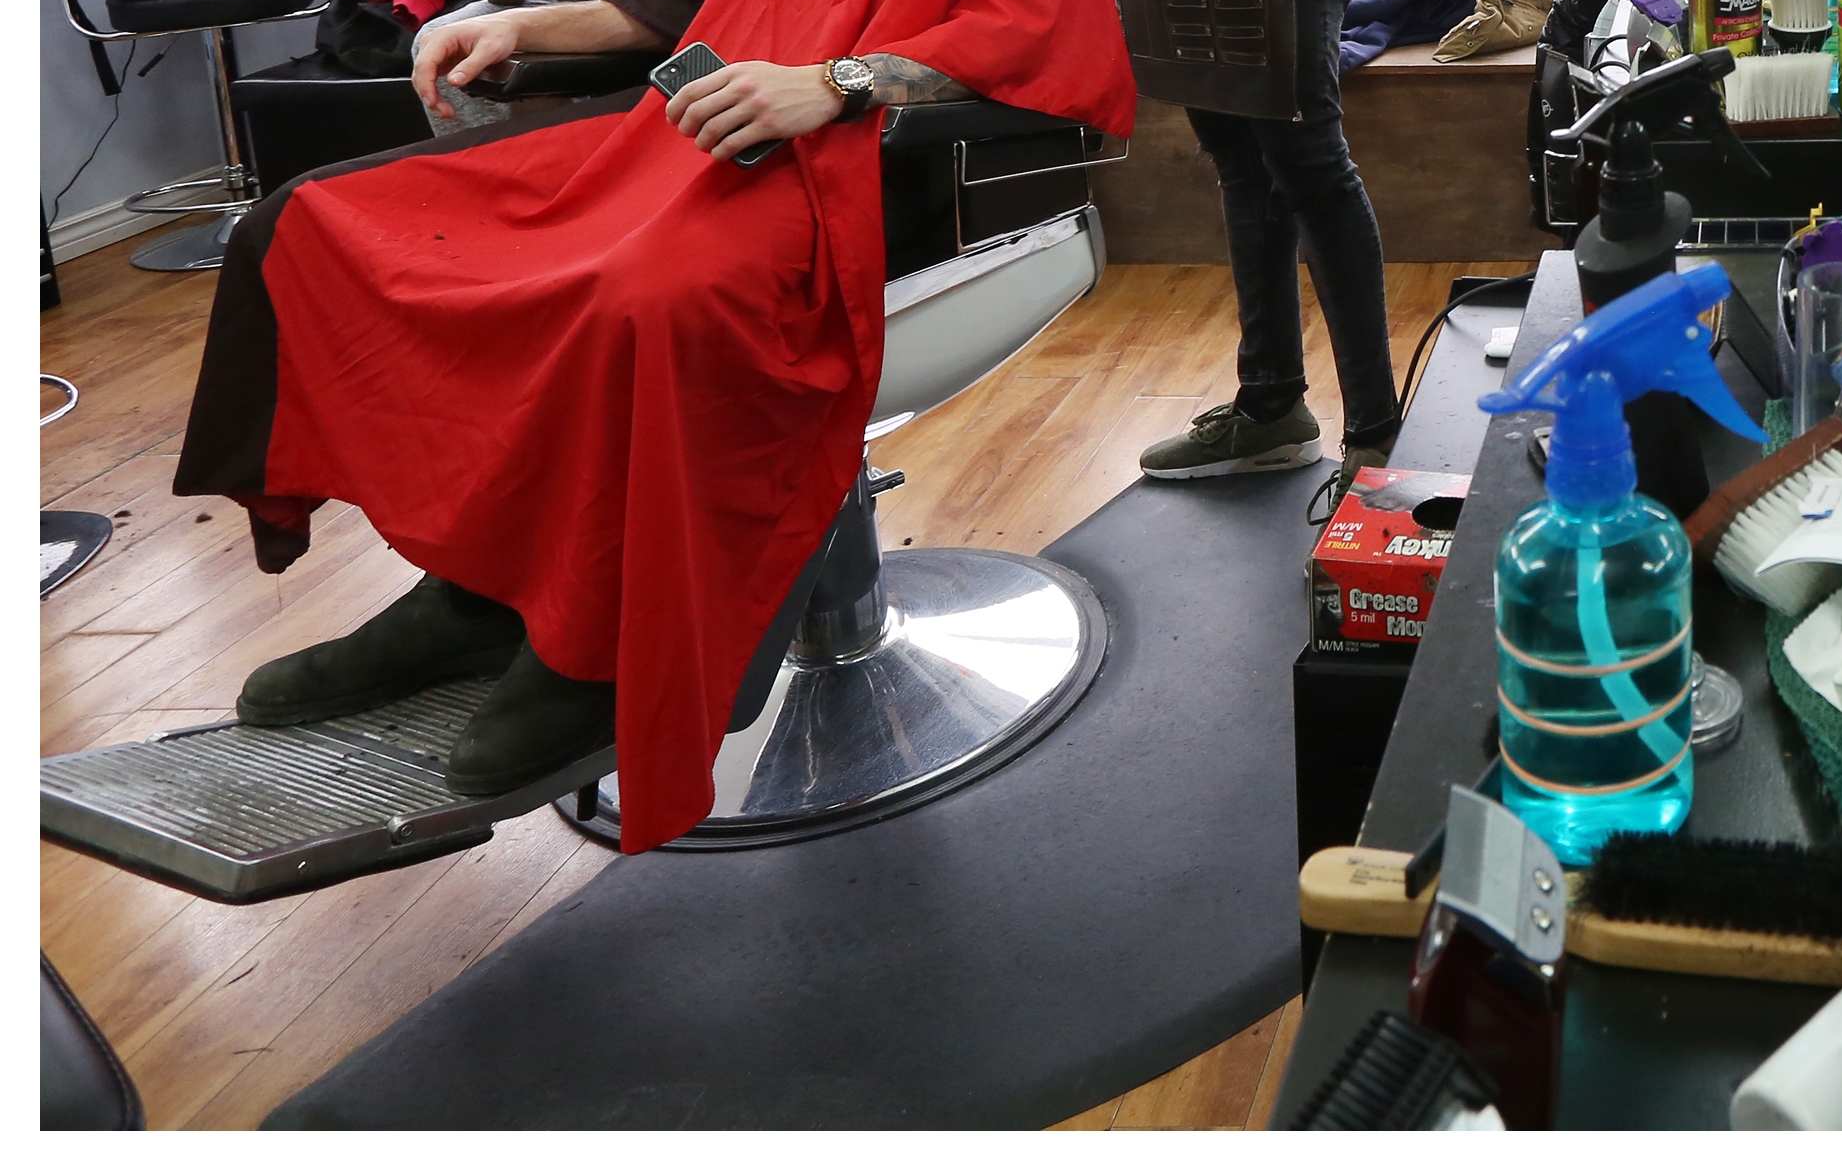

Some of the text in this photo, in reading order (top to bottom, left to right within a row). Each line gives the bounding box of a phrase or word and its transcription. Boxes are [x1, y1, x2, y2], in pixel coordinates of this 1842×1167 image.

[1712, 32, 1739, 41] Private
[1332, 522, 1363, 531] M/M
[1324, 540, 1360, 550] NITRILE
[1385, 535, 1453, 560] nkey
[1349, 588, 1419, 613] Grease
[1351, 611, 1376, 623] 5 mil
[1386, 615, 1427, 638] Mon
[1318, 639, 1344, 652] M/M
